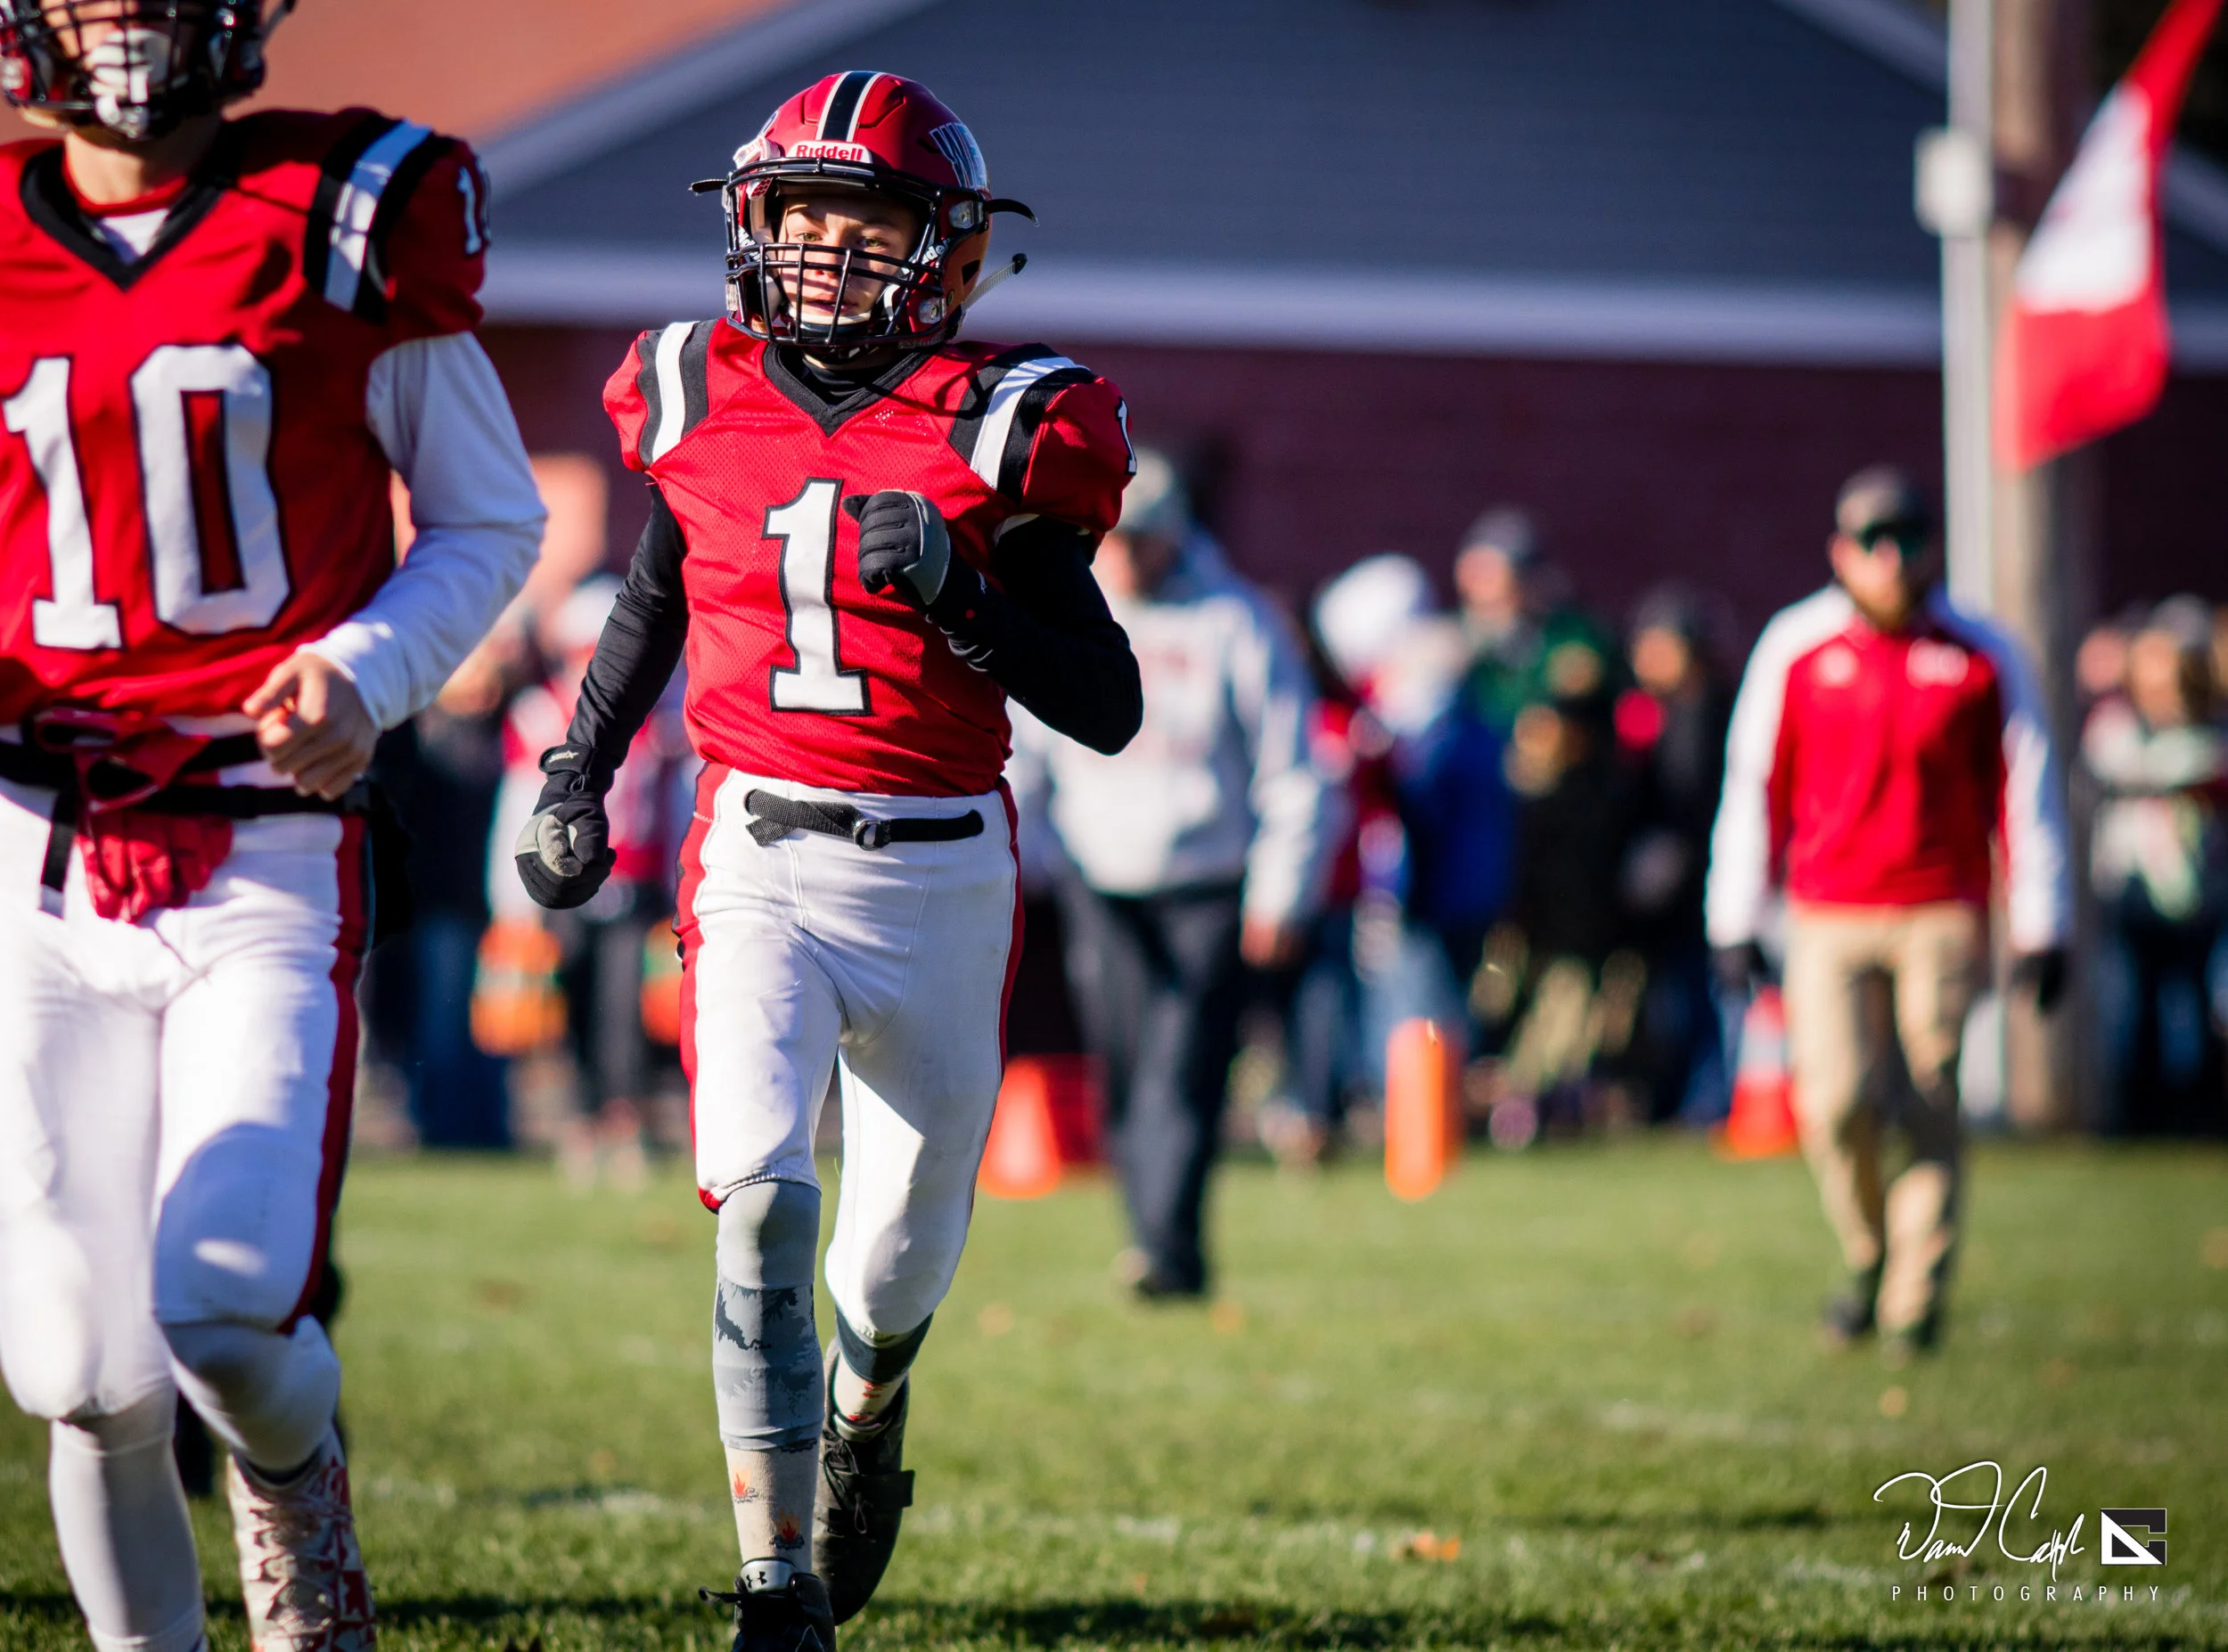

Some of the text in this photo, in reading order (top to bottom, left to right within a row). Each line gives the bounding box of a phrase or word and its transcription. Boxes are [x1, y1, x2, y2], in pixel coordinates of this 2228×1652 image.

[796, 144, 864, 160] Riddell
[2, 340, 292, 652] 10
[761, 477, 872, 716] 1
